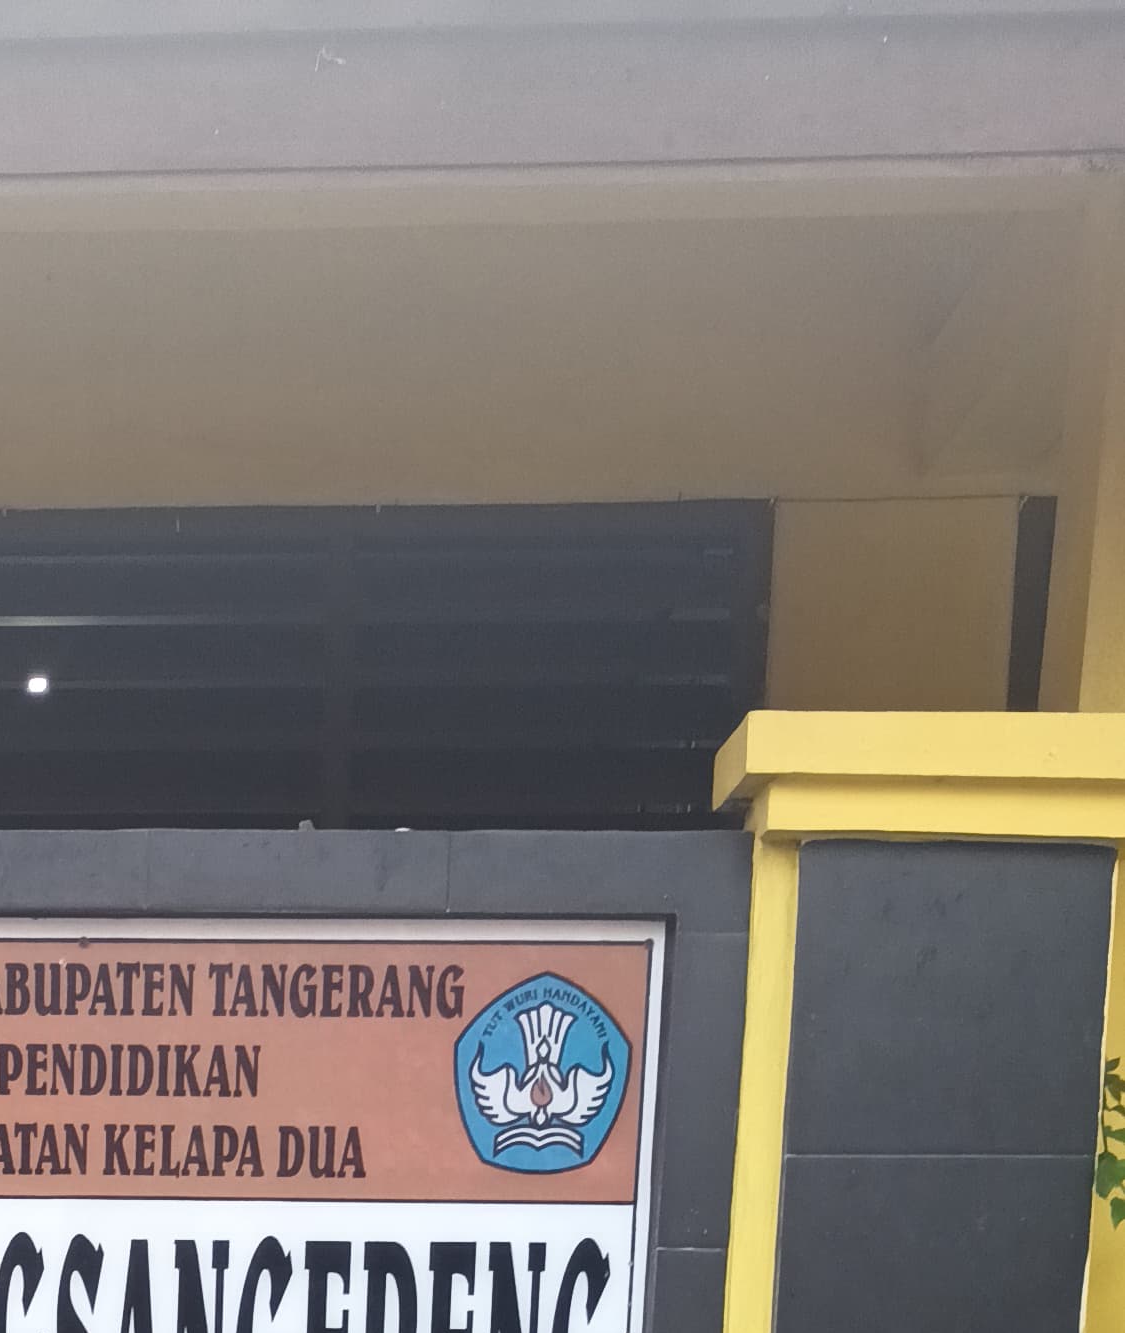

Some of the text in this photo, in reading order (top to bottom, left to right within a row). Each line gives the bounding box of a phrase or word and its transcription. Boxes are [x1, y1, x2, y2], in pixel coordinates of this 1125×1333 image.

[208, 962, 465, 1020] TANGERANG
[483, 1011, 503, 1037] TUT
[503, 990, 538, 1013] WURI
[102, 1123, 265, 1178] KELAPA
[276, 1125, 367, 1179] DUA
